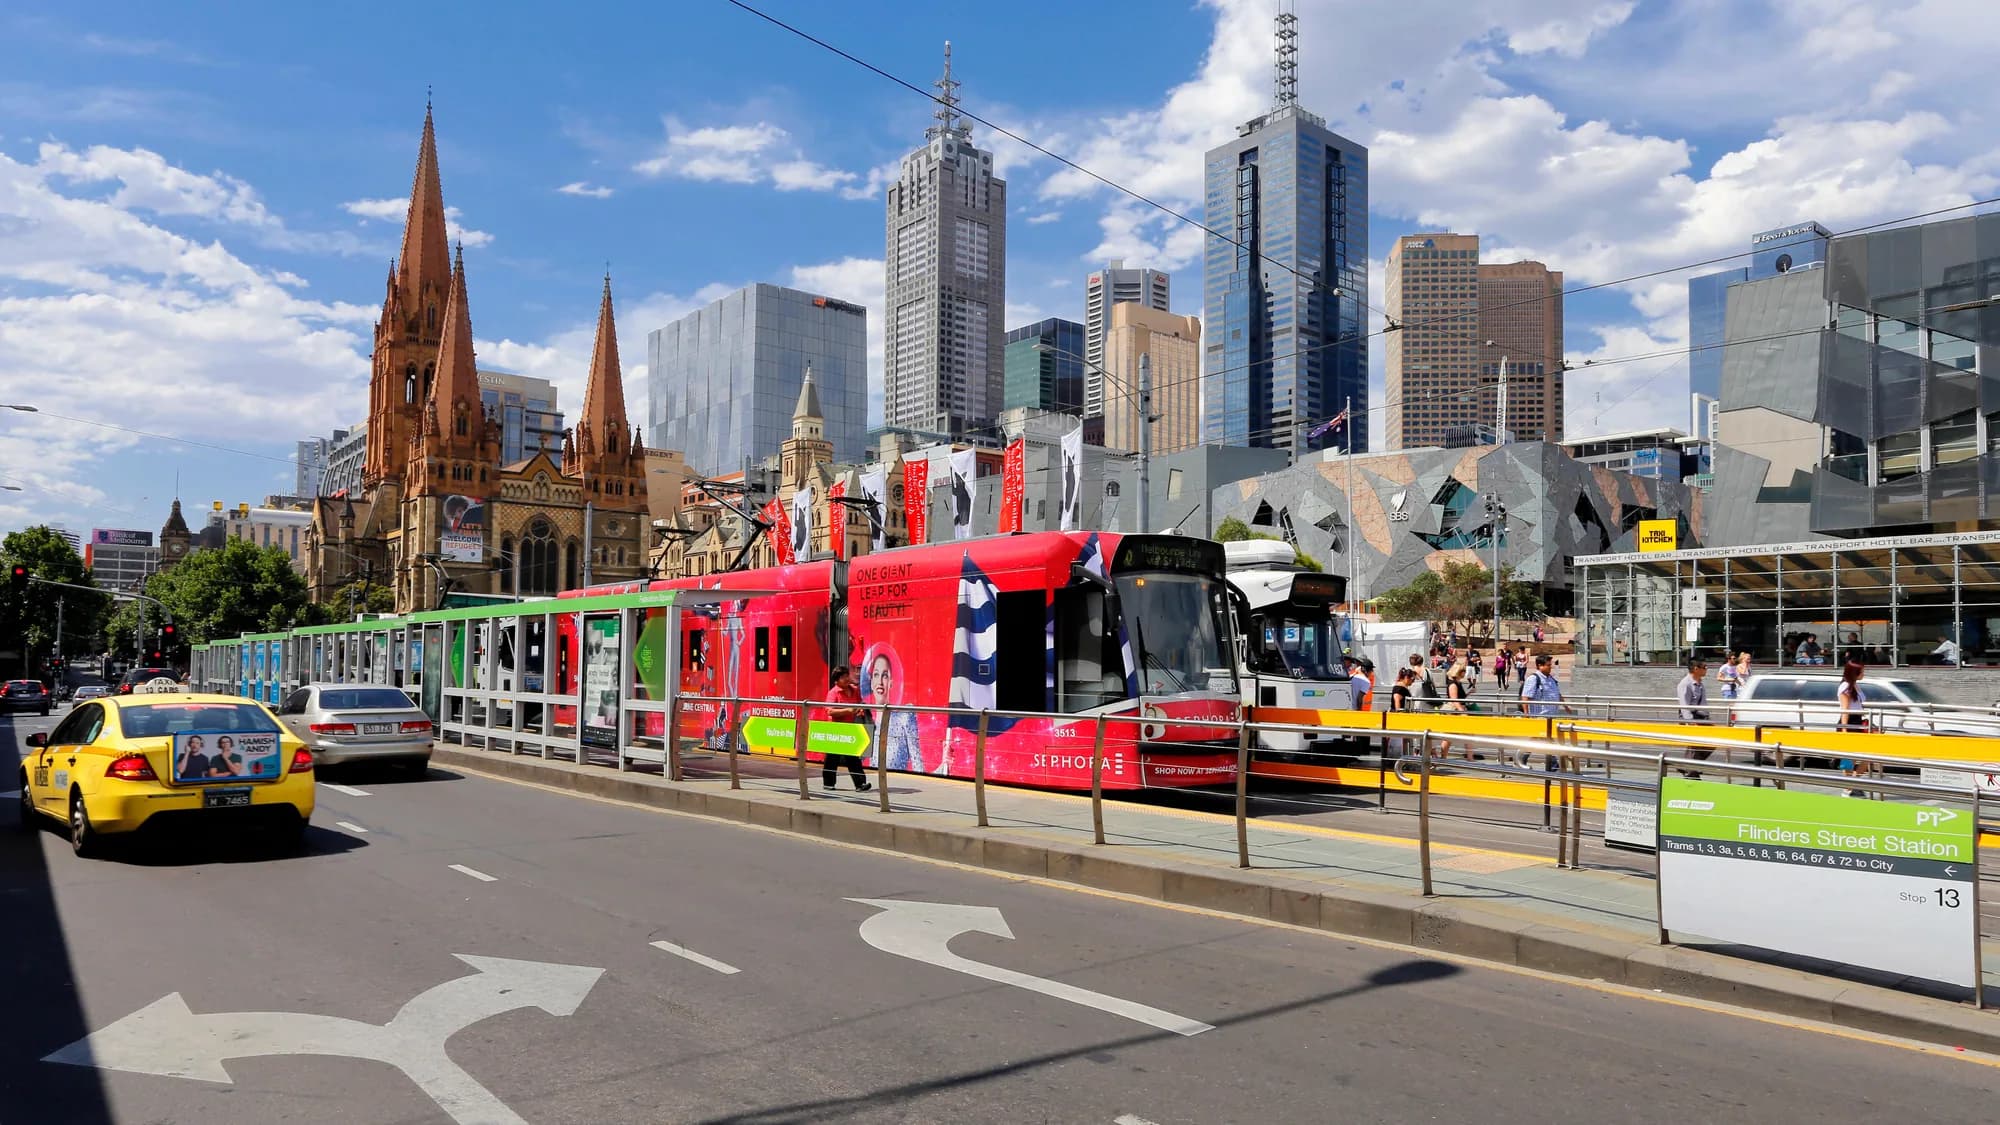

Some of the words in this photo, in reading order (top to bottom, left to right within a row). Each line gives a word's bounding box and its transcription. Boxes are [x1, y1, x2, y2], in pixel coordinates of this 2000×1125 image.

[1390, 512, 1408, 521] SBS
[1642, 536, 1673, 544] KITCHEN
[1575, 555, 1621, 564] TRANSPORT
[1682, 549, 1738, 557] TRANSPORT
[1805, 541, 1866, 550] TRANSPORT
[1870, 538, 1906, 546] HOTEL
[856, 568, 877, 582] ONE
[888, 583, 908, 598] FOR
[752, 707, 781, 717] NOVEMBER
[782, 709, 795, 718] 2015
[1054, 728, 1076, 738] 3513
[238, 737, 275, 745] HAMISH
[245, 745, 271, 753] ANDY
[1154, 767, 1176, 775] SHOP
[1738, 824, 1810, 844] Flinders
[1817, 830, 1877, 850] Street
[1884, 835, 1958, 857] Station
[1665, 840, 1694, 851] Trams
[1697, 843, 1704, 852] 1,
[1707, 844, 1715, 854] 3,
[1719, 845, 1734, 856] 3a,
[1737, 847, 1746, 857] 5,
[1749, 848, 1758, 858] 6,
[1761, 849, 1770, 860] 8,
[1775, 851, 1788, 861] 16,
[1791, 852, 1807, 863] 64,
[1811, 854, 1823, 863] 67
[1827, 855, 1836, 864] &
[1839, 856, 1852, 867] 72
[1856, 858, 1867, 868] to
[1870, 859, 1894, 872] City
[1899, 891, 1927, 905] Stop
[1934, 887, 1960, 909] 13
